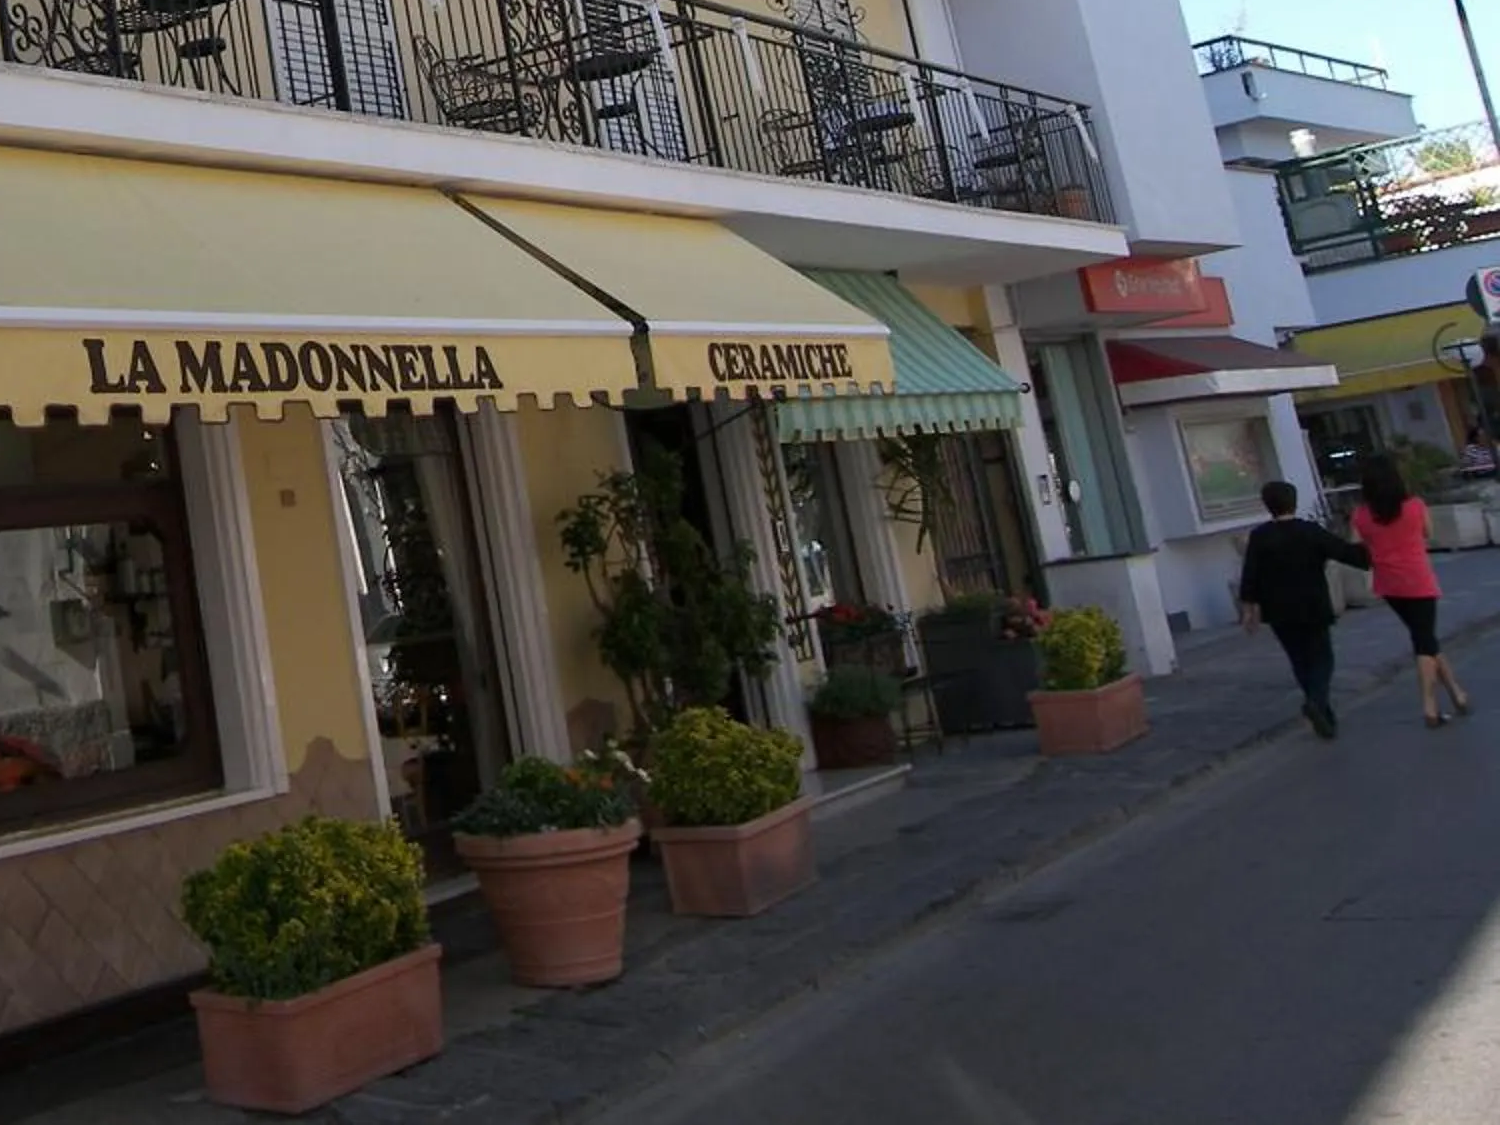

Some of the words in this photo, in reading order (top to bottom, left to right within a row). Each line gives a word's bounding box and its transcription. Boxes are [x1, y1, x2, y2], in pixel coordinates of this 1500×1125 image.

[83, 338, 166, 393] LA
[175, 340, 504, 393] MADONNELLA
[708, 342, 853, 382] CERAMICHE
